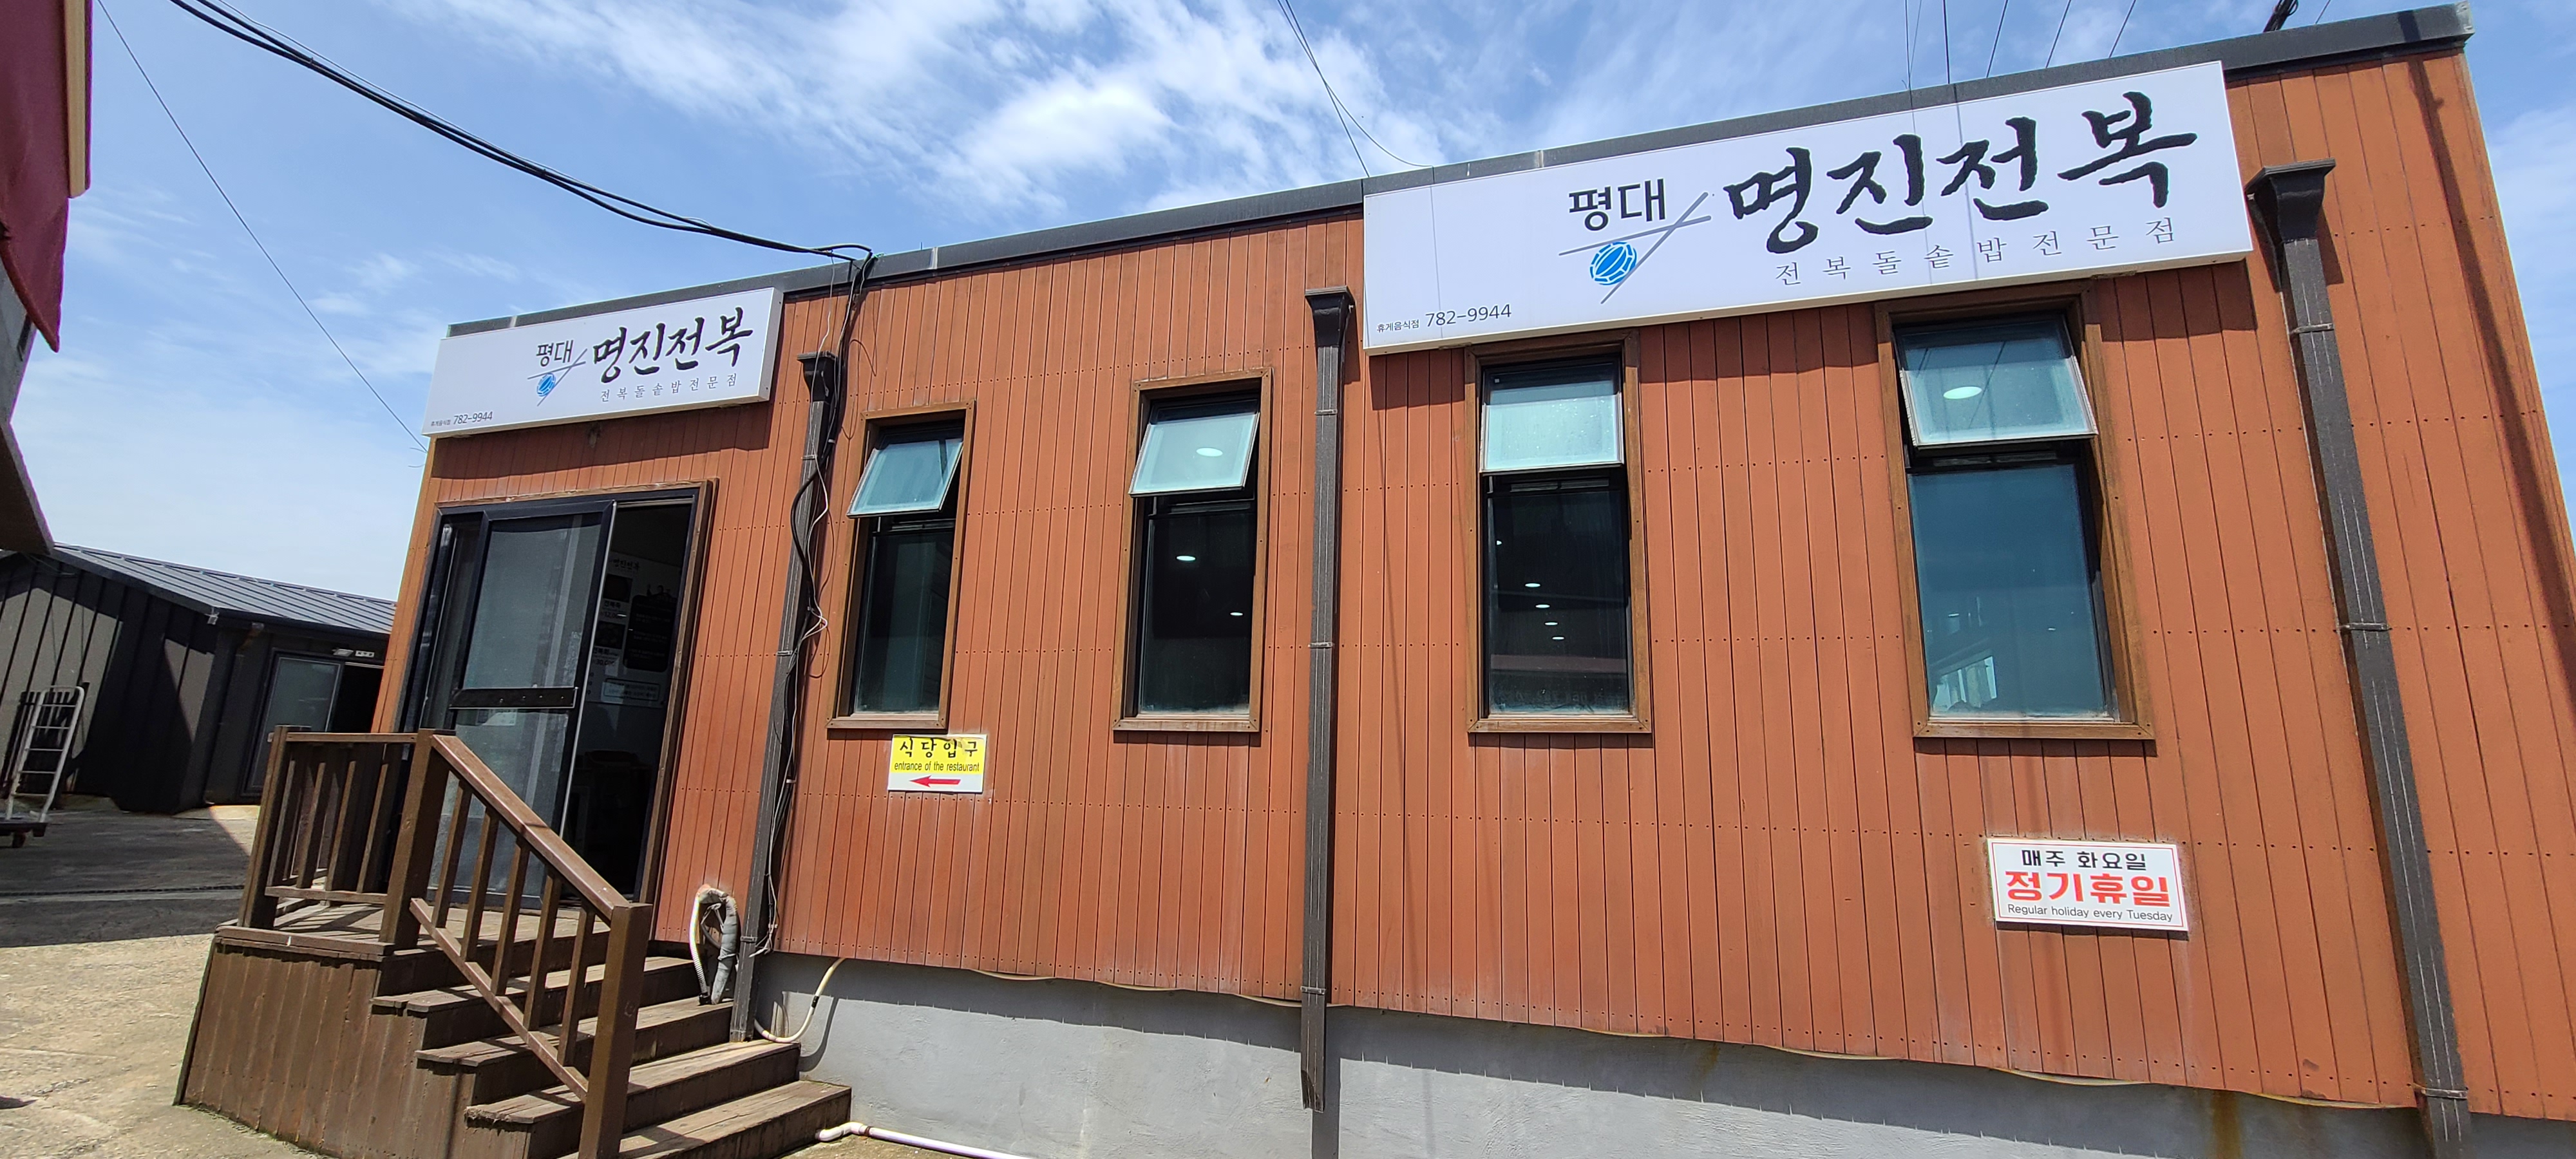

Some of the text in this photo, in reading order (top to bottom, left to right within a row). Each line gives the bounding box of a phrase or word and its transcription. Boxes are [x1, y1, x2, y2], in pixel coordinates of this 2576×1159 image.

[1723, 92, 2197, 254] 명진전복
[1569, 178, 1666, 231] 평대
[1377, 304, 1511, 333] 휴게음식점 782-9944
[536, 340, 573, 368] 평대
[593, 307, 753, 383] 명진전복
[453, 411, 493, 425] 782-9944
[900, 737, 978, 759] 식당입구
[895, 761, 980, 771] entrance of the restaurant
[2022, 849, 2146, 871] 매주 화요일
[2005, 871, 2171, 907] 정기휴일
[2008, 904, 2173, 922] Regular holiday every Tuesday
